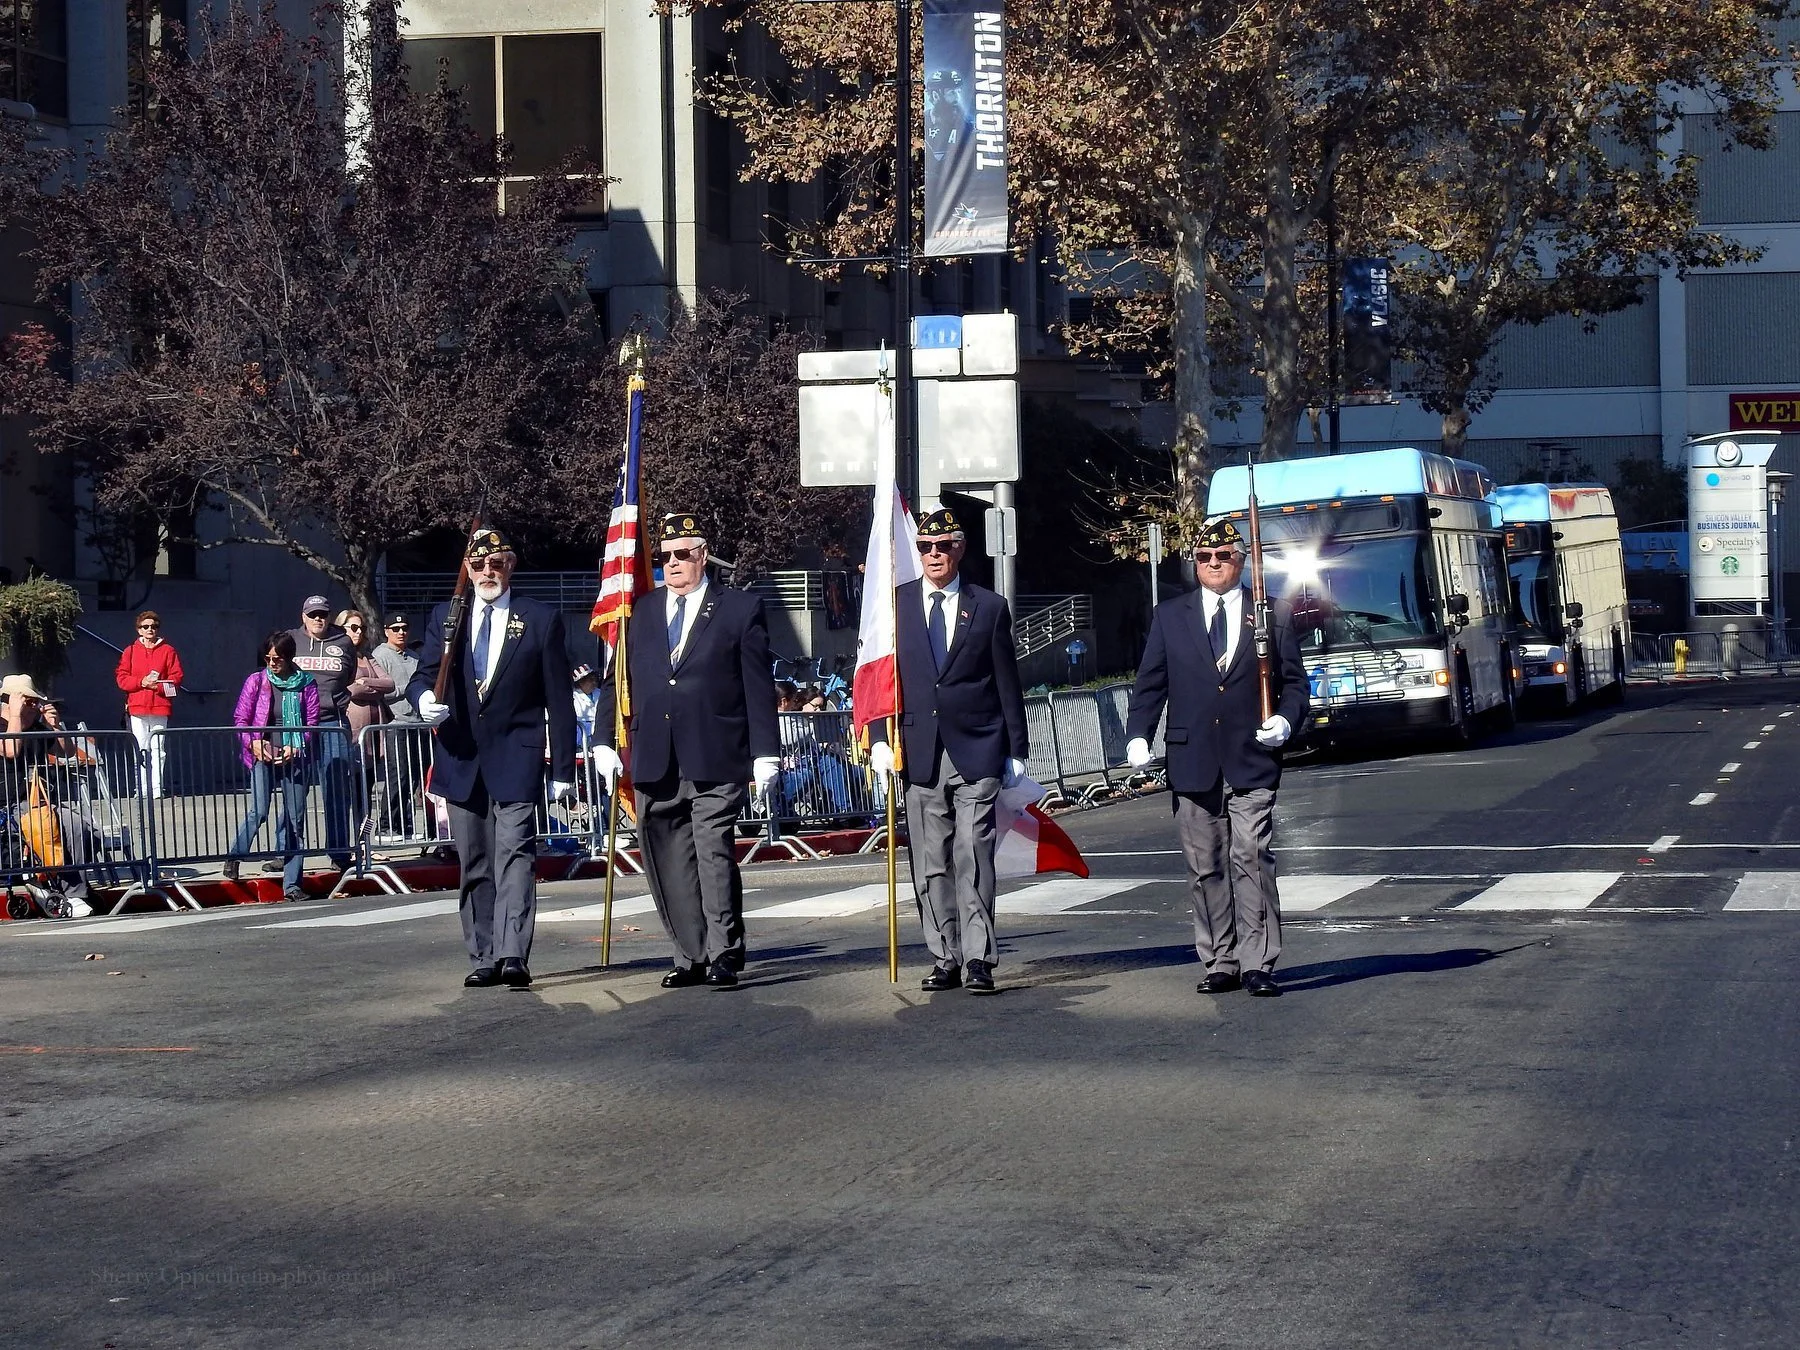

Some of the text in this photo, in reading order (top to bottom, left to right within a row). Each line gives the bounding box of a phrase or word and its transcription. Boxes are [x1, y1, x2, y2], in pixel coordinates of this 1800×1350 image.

[973, 11, 1004, 171] THORNTON
[1370, 267, 1388, 327] VLASIC
[1705, 513, 1752, 522] SILICON VALLEY
[1697, 521, 1760, 530] BUSINESS JOURNAL
[1506, 533, 1516, 547] E
[1716, 536, 1760, 549] Specialty's
